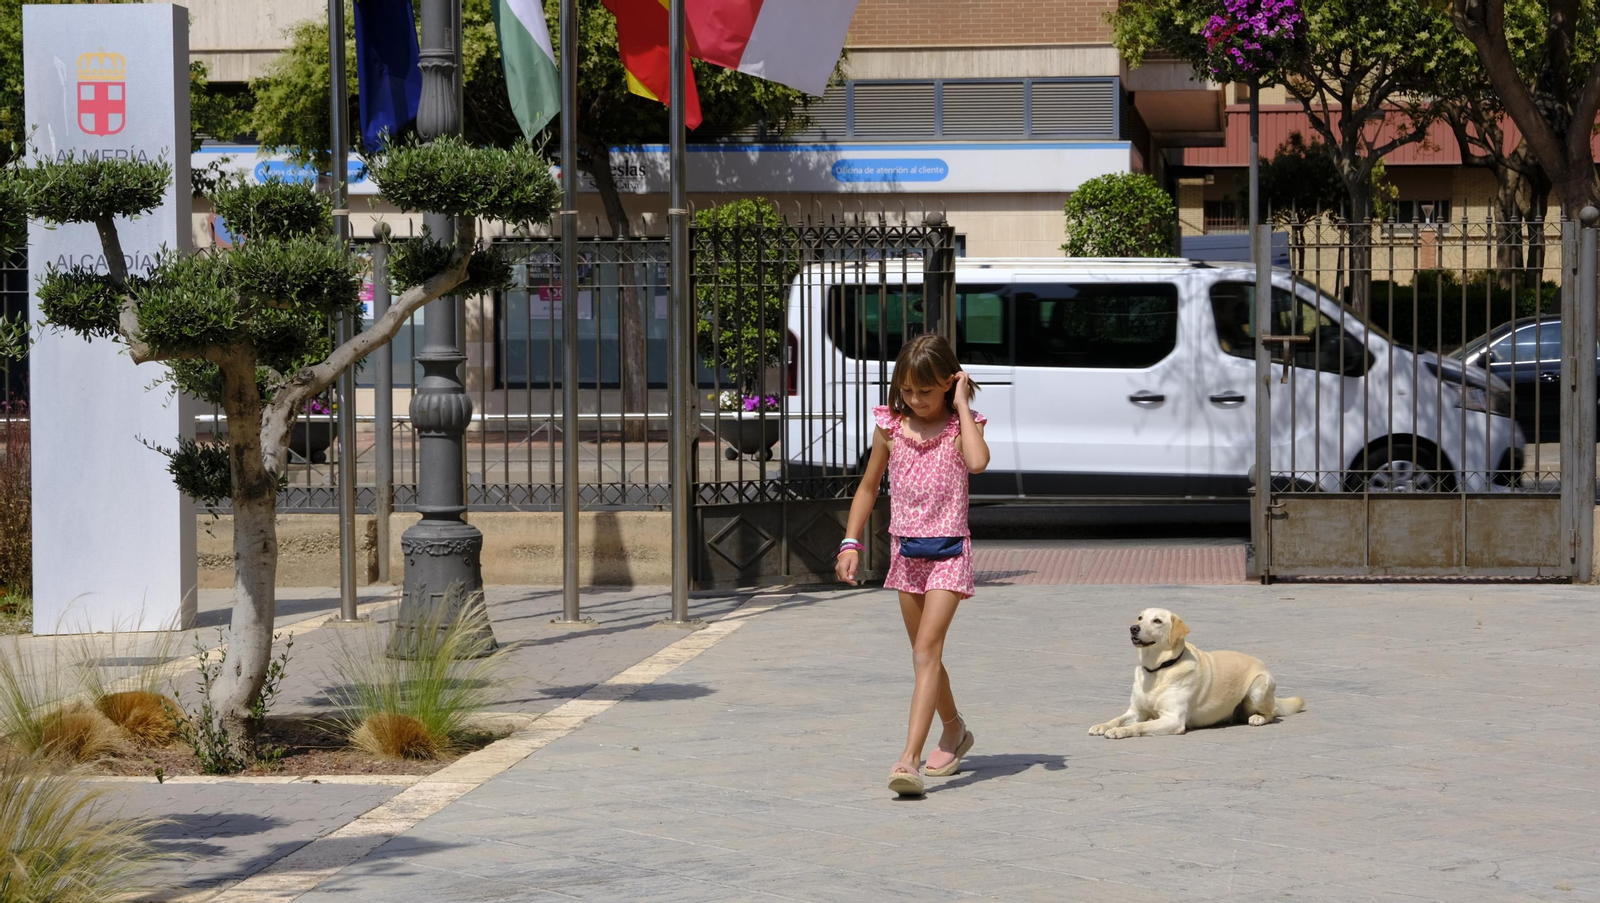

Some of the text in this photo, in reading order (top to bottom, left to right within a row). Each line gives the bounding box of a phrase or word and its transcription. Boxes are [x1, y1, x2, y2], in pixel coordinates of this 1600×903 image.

[836, 166, 944, 175] Oficina de atención al cliente
